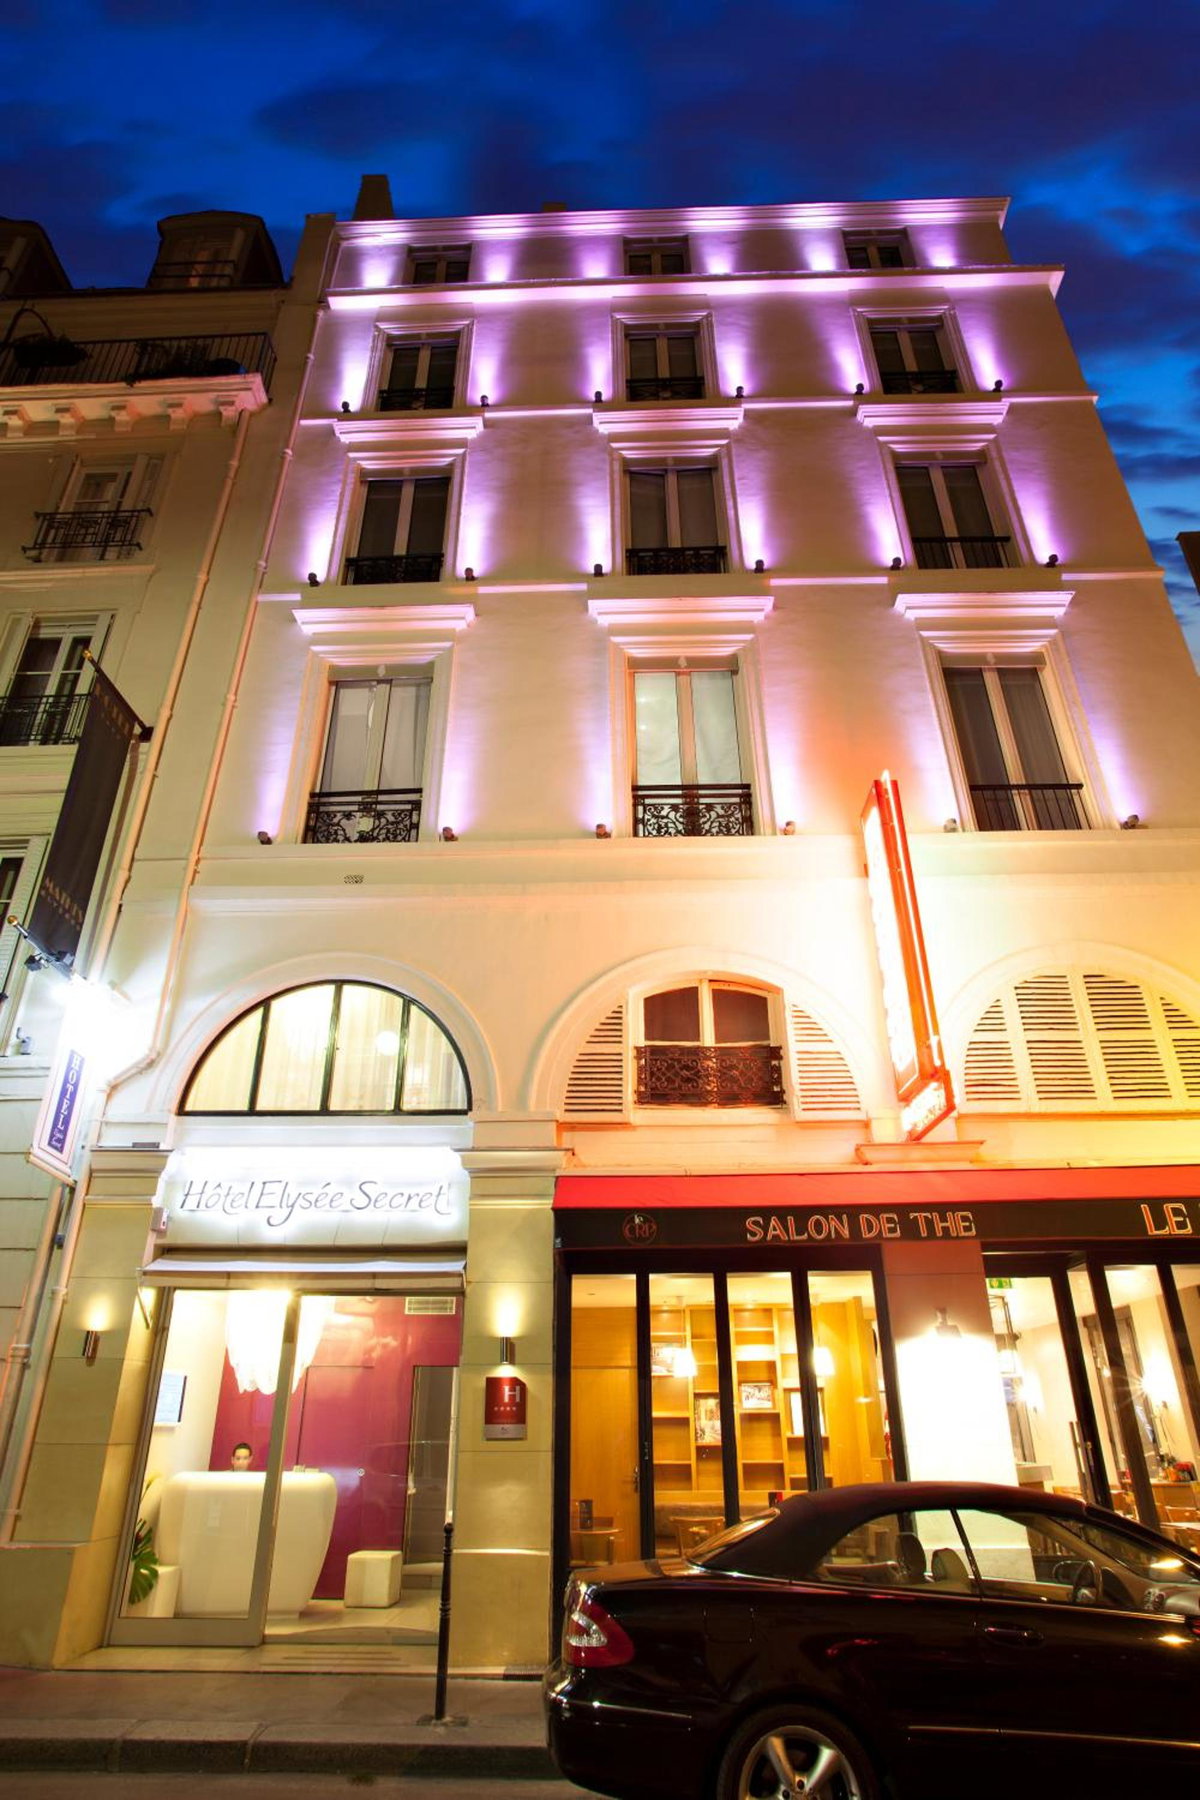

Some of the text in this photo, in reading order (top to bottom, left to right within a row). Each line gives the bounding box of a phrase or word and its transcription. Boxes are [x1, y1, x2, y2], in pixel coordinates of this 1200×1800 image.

[58, 1053, 81, 1130] HOTEL
[179, 1180, 453, 1227] Hôtel Elysée Secret
[1140, 1203, 1193, 1235] LE
[745, 1211, 977, 1241] SALON DE THE
[503, 1385, 520, 1403] H
